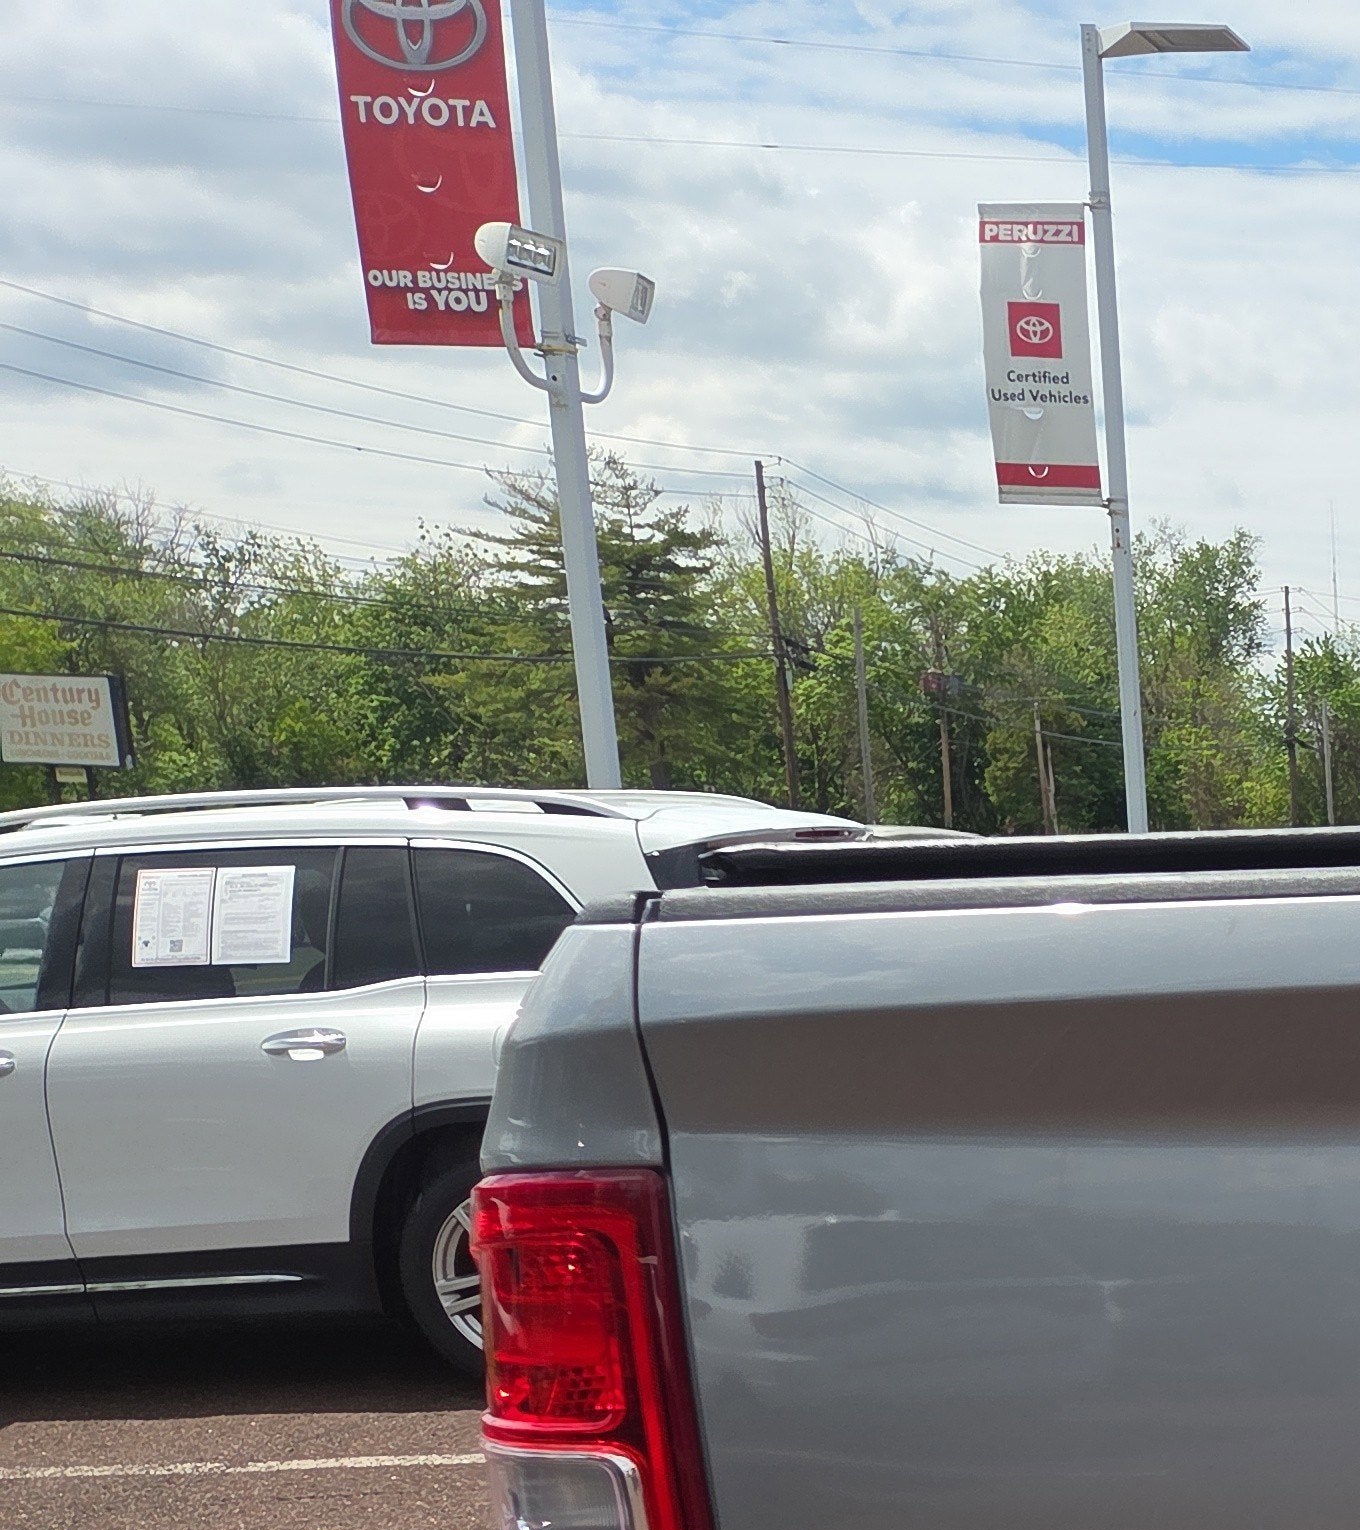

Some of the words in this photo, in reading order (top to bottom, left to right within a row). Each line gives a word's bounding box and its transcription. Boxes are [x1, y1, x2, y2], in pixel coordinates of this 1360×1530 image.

[350, 95, 496, 128] TOYOTA
[984, 223, 1079, 242] PERUZZI
[368, 269, 413, 288] OUR
[416, 270, 523, 291] BUSINES
[430, 290, 488, 312] YOU
[1006, 369, 1070, 385] Certified
[991, 387, 1026, 402] Used
[1028, 388, 1090, 405] Vehicles
[1, 679, 101, 711] Century
[17, 704, 92, 728] House
[7, 730, 111, 748] DINNERS
